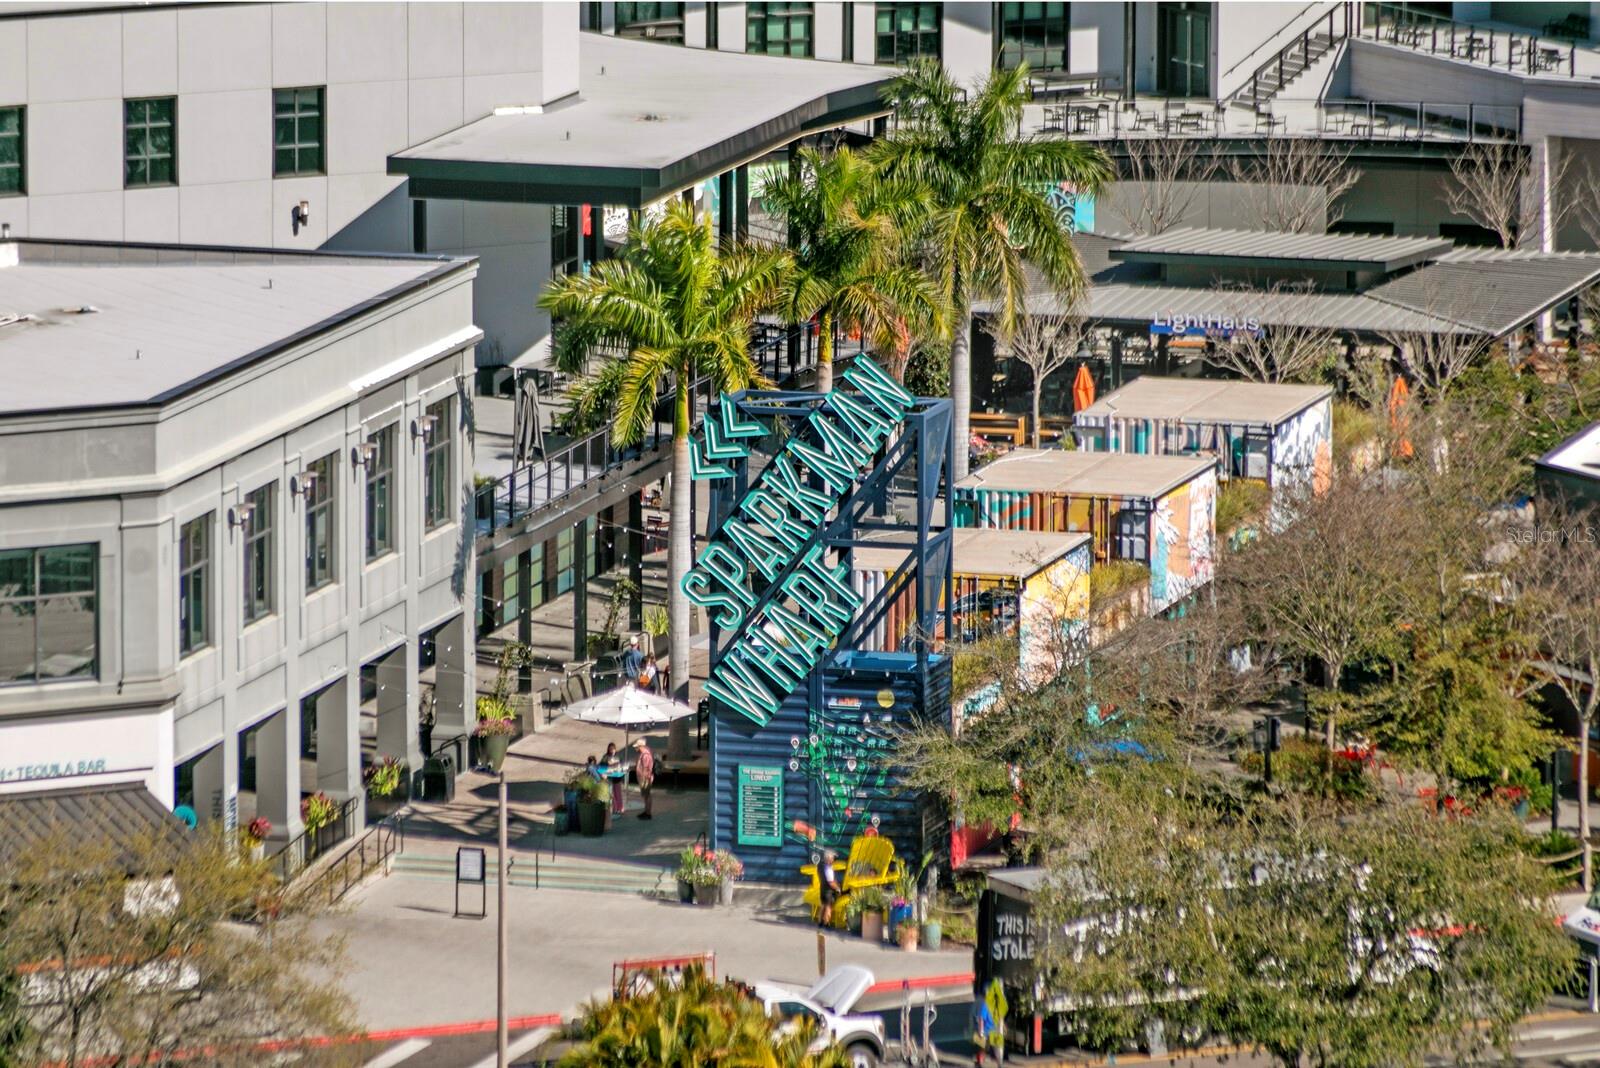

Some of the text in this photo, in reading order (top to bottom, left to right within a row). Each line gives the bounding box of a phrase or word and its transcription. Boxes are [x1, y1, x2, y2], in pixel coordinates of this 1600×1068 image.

[1154, 311, 1260, 333] LightHaus
[679, 353, 917, 631] SPARKMAN
[703, 541, 865, 728] WHARF
[16, 761, 74, 780] TEQUILA
[78, 758, 106, 775] BAR
[996, 915, 1023, 936] THIS
